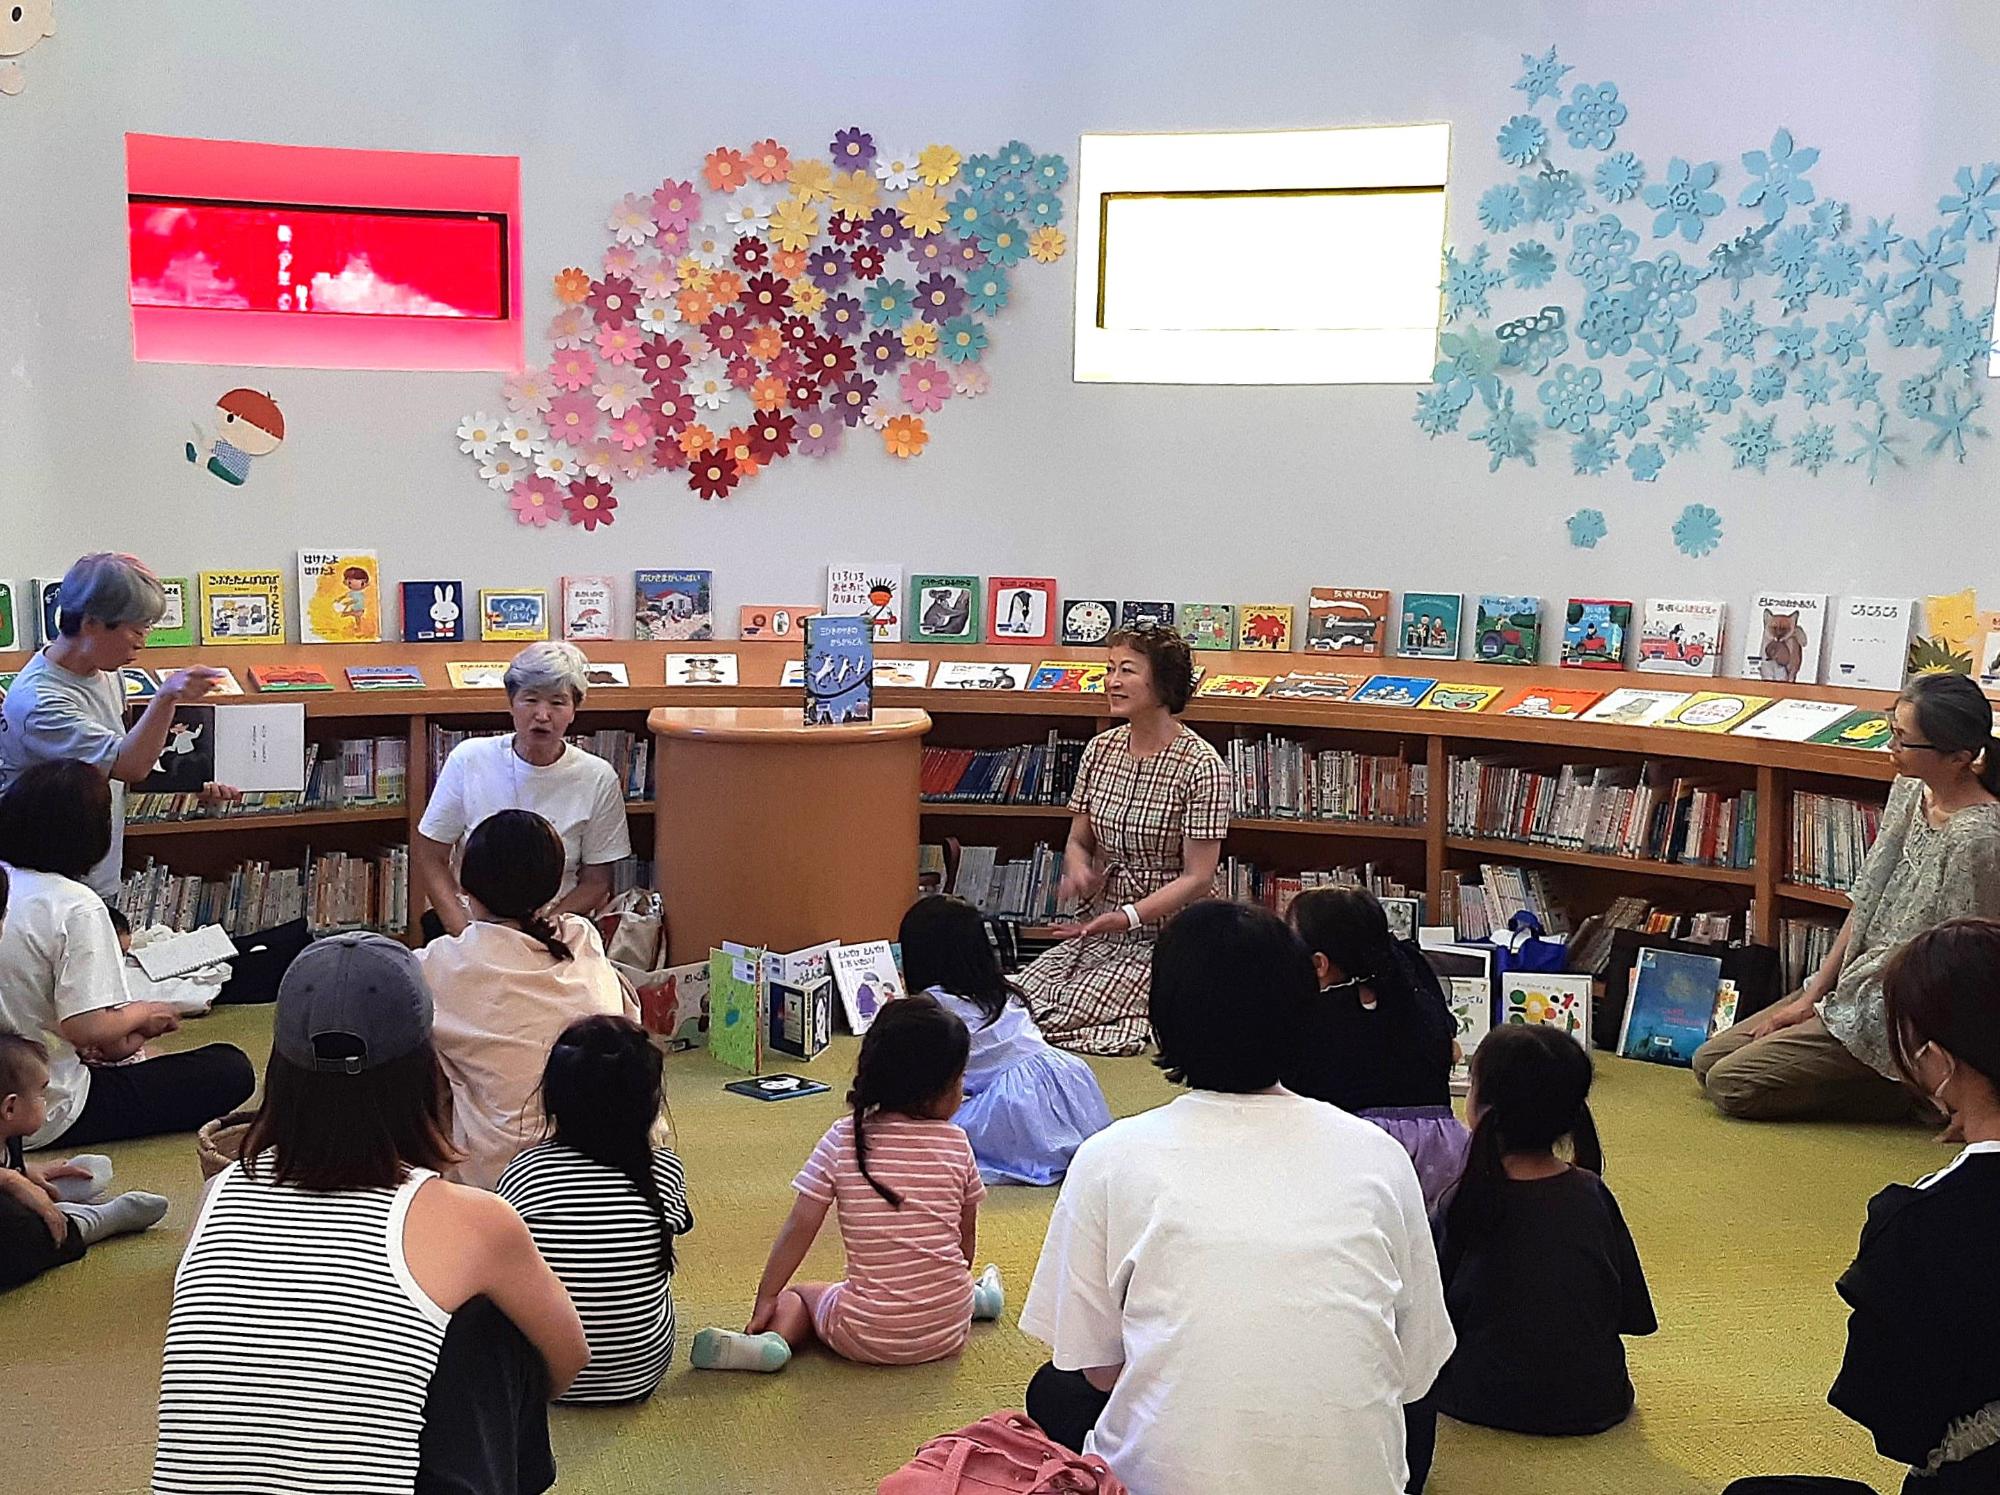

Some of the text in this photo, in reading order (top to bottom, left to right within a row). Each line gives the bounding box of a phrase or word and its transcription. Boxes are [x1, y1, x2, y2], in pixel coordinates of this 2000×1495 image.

[303, 554, 339, 565] はけたよ
[304, 566, 336, 576] はけたよ
[832, 570, 864, 582] いろいろ
[832, 583, 864, 593] おせわに
[832, 594, 866, 605] なりました
[1851, 604, 1898, 619] ころころころ
